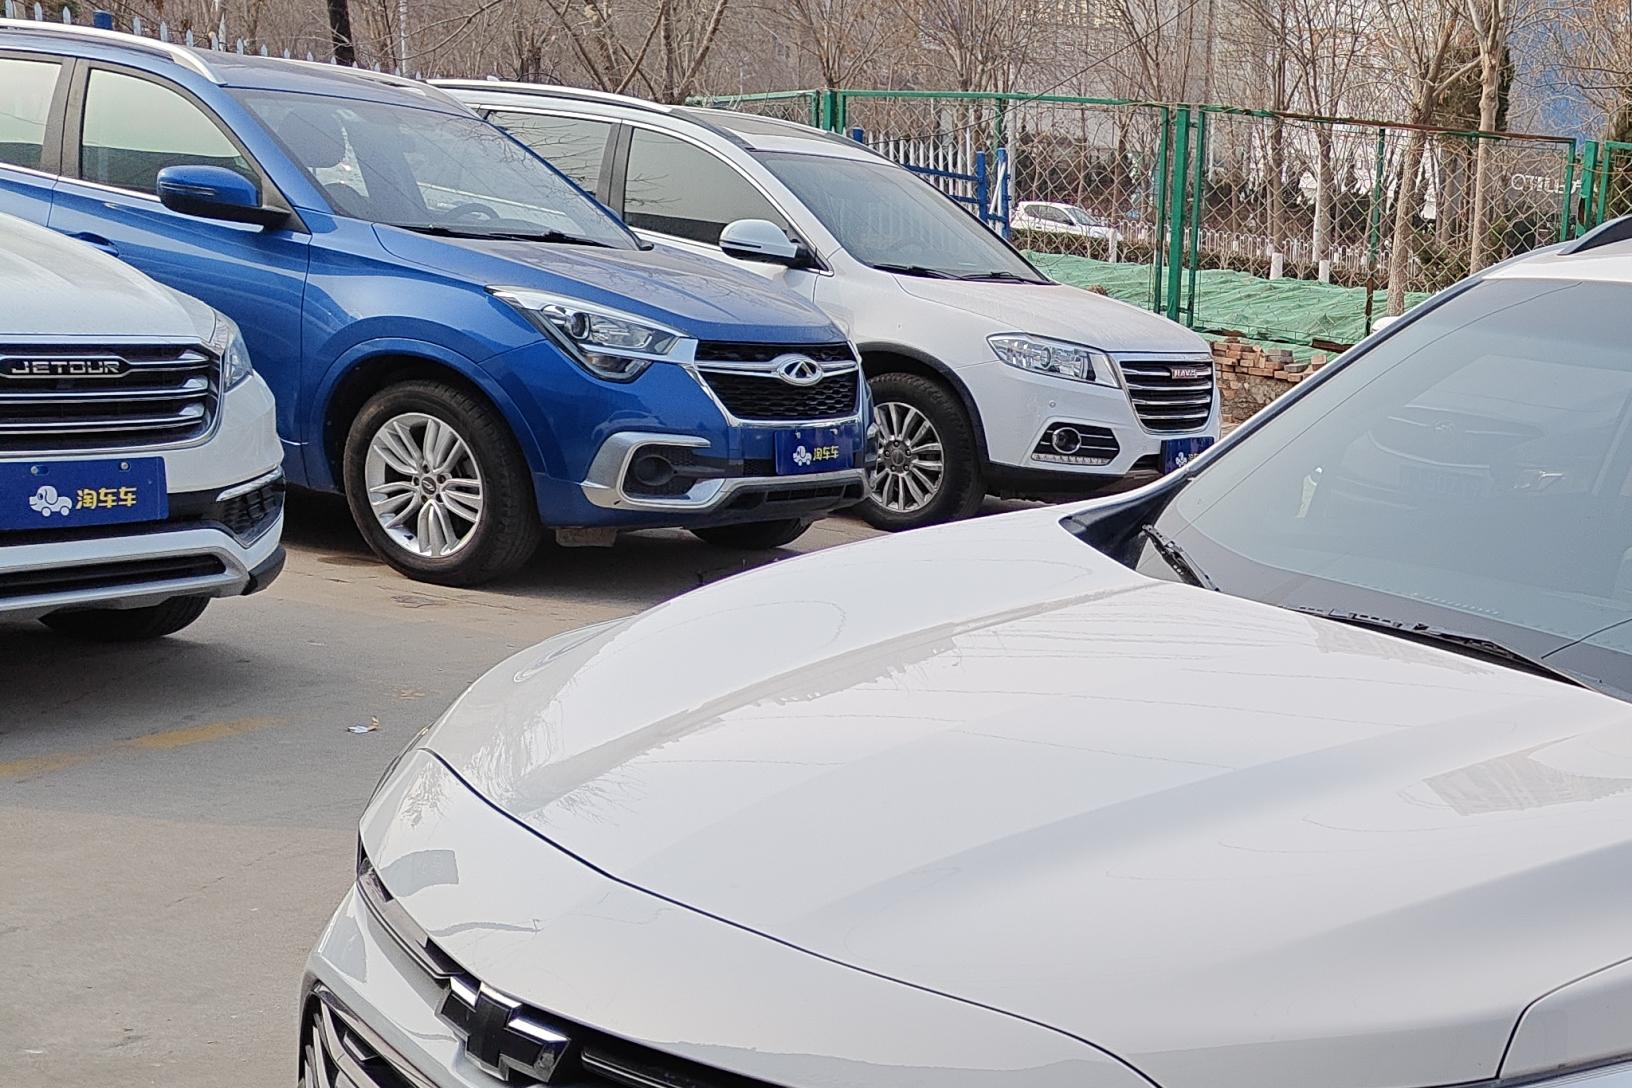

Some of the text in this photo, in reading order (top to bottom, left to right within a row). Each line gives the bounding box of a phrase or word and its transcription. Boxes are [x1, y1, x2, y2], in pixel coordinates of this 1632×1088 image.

[11, 361, 120, 375] JETOUR
[812, 445, 840, 461] 淘车车
[75, 486, 138, 510] 淘车车
